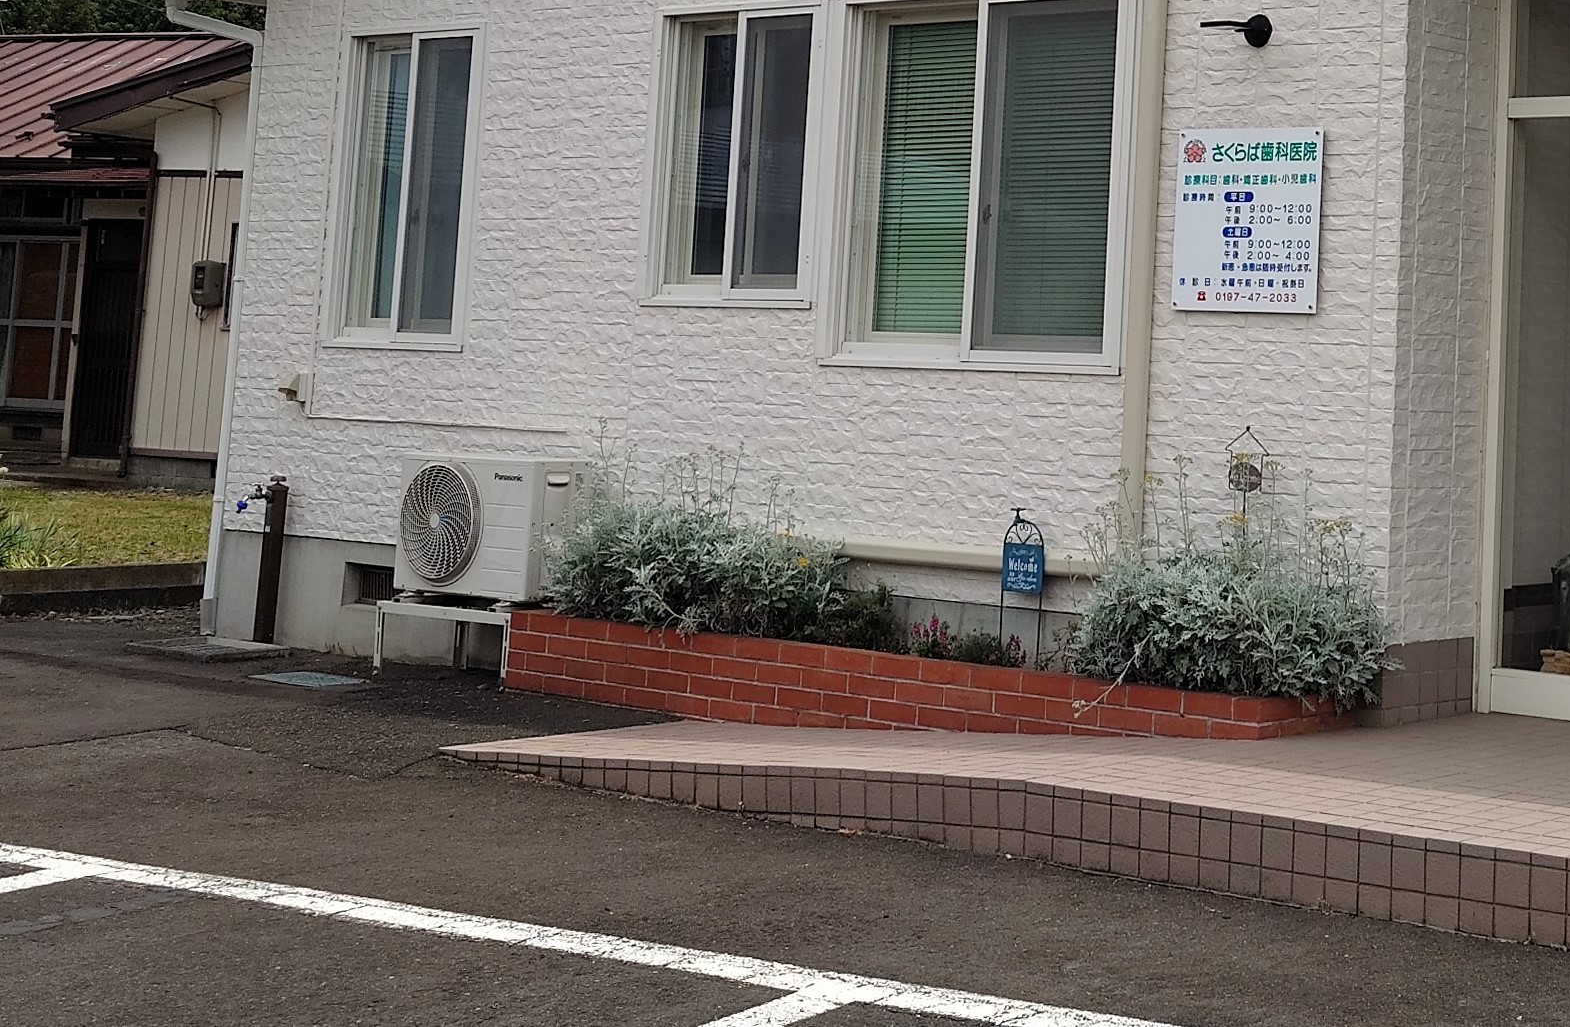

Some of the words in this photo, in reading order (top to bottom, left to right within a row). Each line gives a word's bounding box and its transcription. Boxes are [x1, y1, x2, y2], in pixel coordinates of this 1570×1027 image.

[1211, 141, 1318, 163] さくらば歯科医院
[1215, 291, 1298, 303] 0197-47-2033
[494, 472, 523, 482] Panasonic
